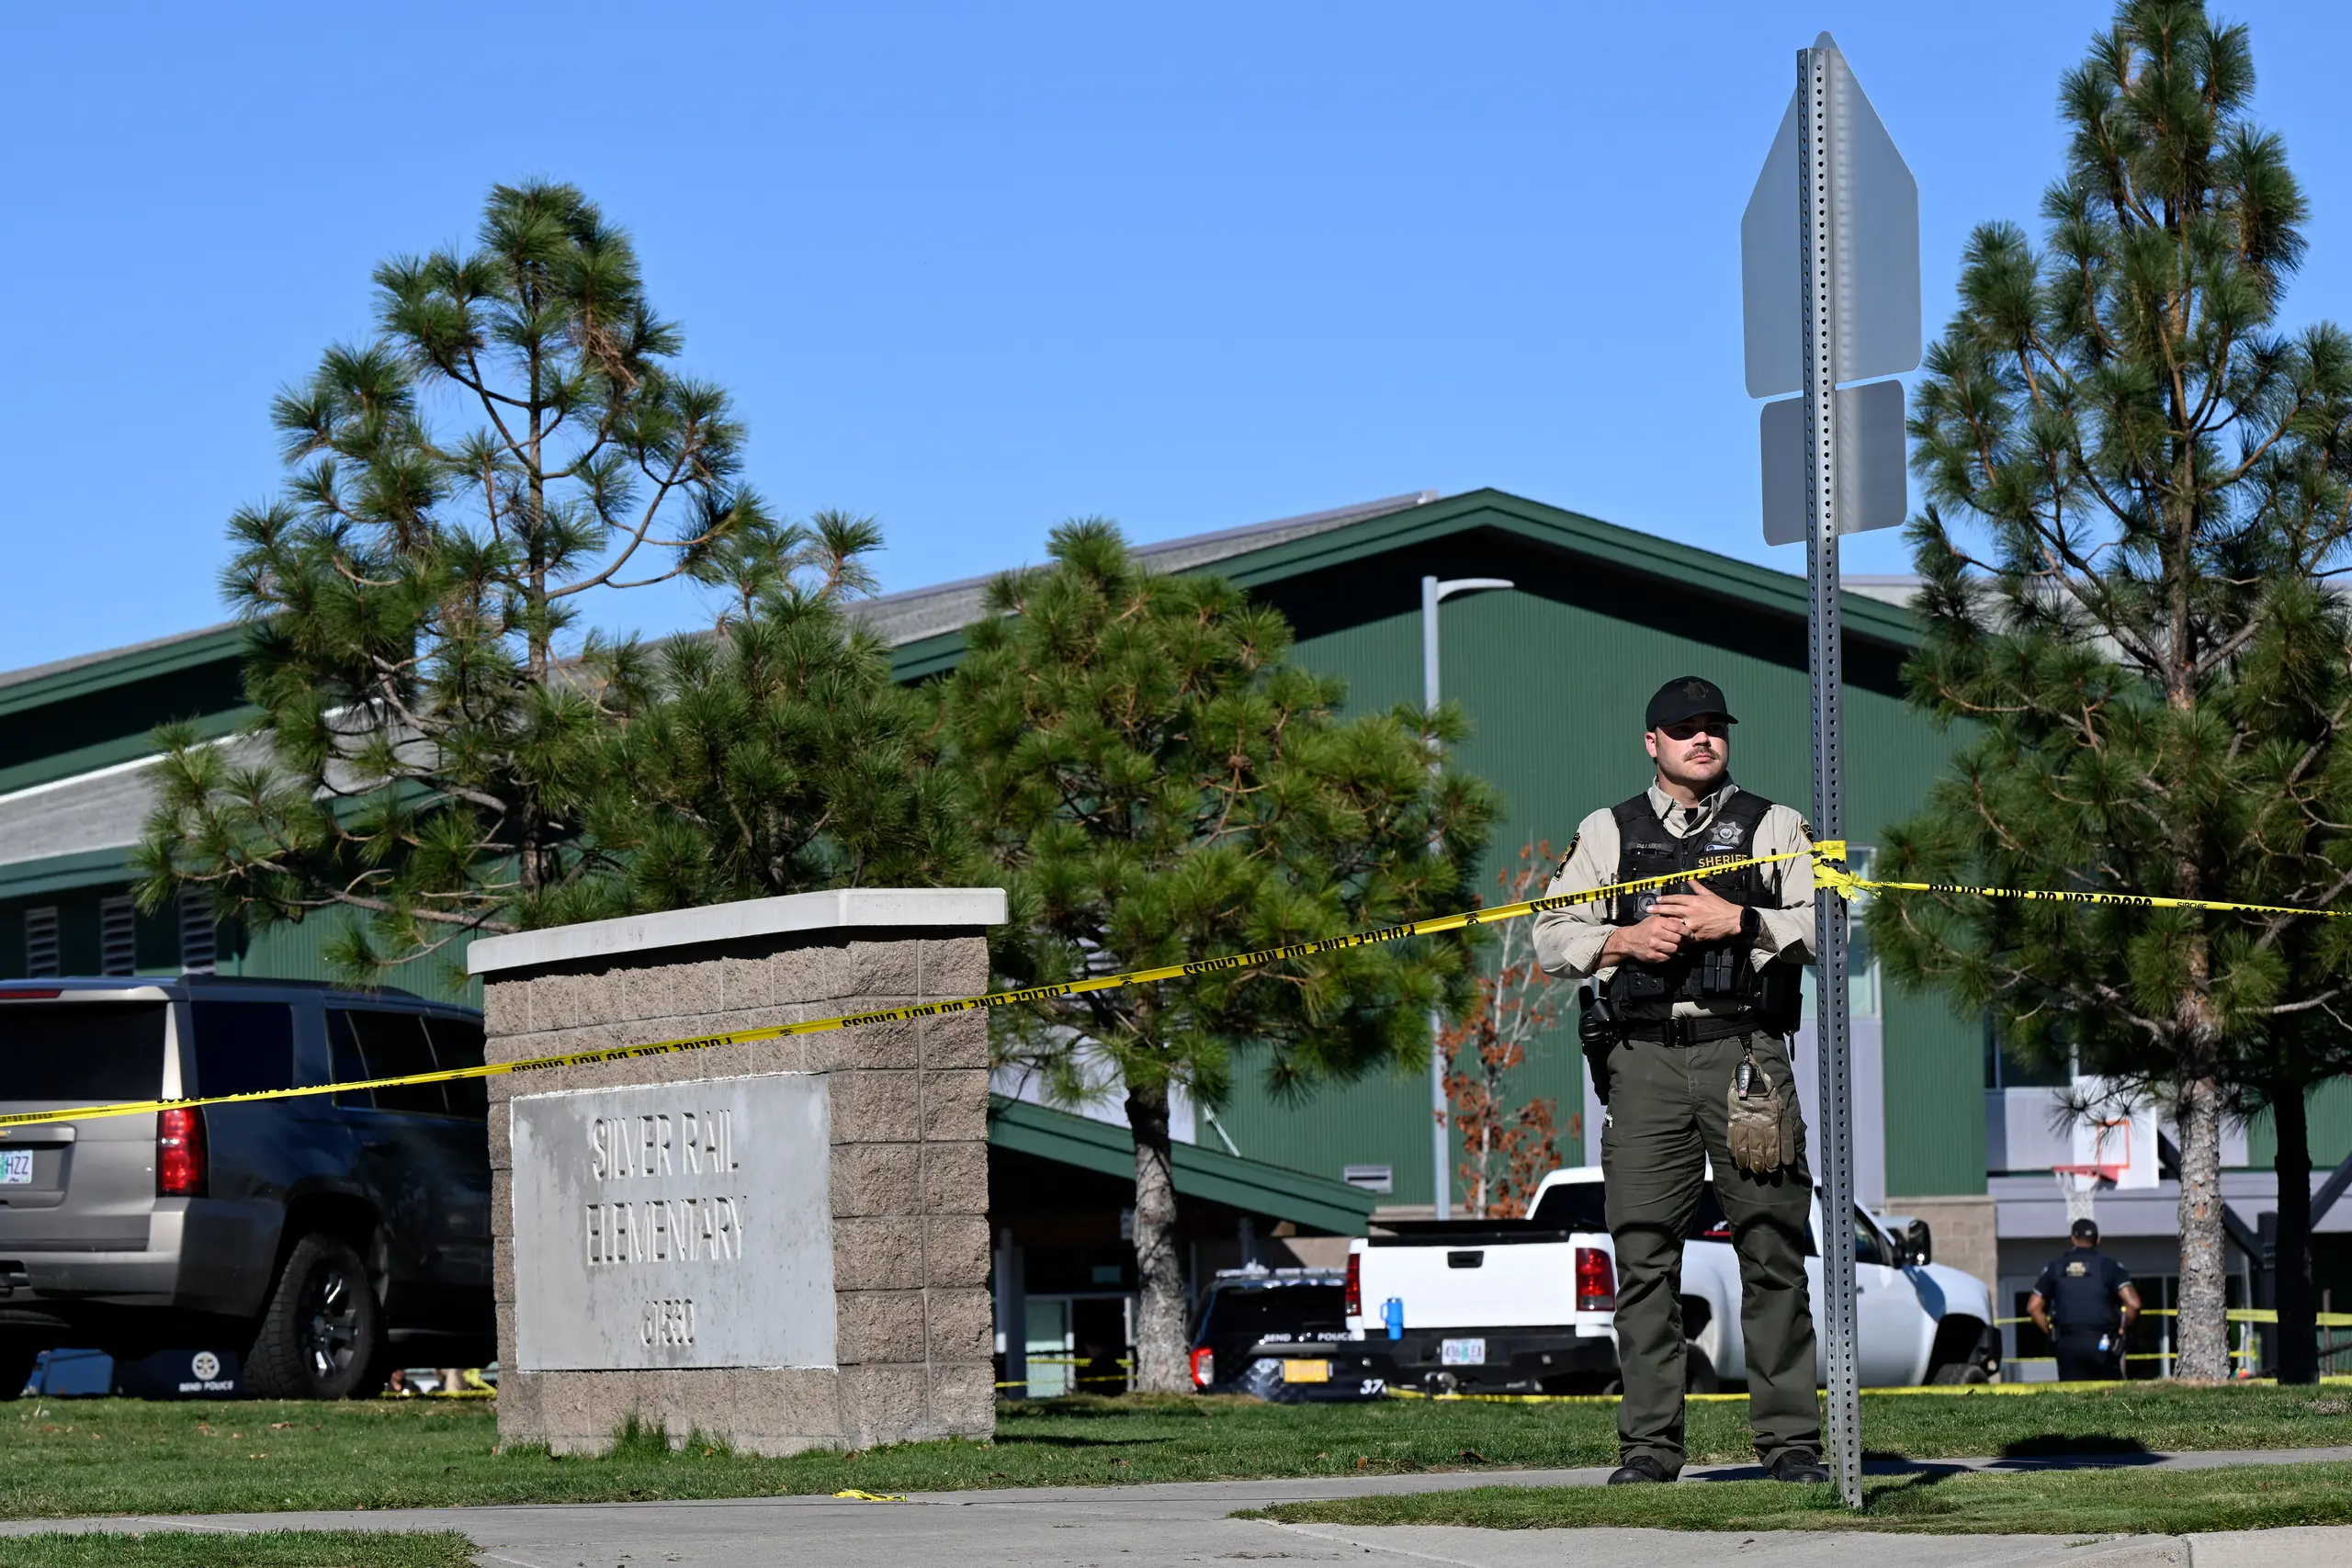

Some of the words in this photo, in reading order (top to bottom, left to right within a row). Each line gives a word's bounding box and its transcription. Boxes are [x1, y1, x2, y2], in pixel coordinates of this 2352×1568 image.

[1311, 936, 1350, 953] LINE
[1353, 924, 1416, 946] POLICE
[1245, 950, 1278, 964] NOT
[1283, 944, 1307, 958] DO
[1182, 956, 1239, 975] CROSS
[593, 1112, 673, 1182] SILVER
[683, 1109, 739, 1176] RAIL
[6, 1156, 29, 1175] HZZ
[586, 1195, 746, 1266] ELEMENTARY
[640, 1298, 695, 1347] 61530
